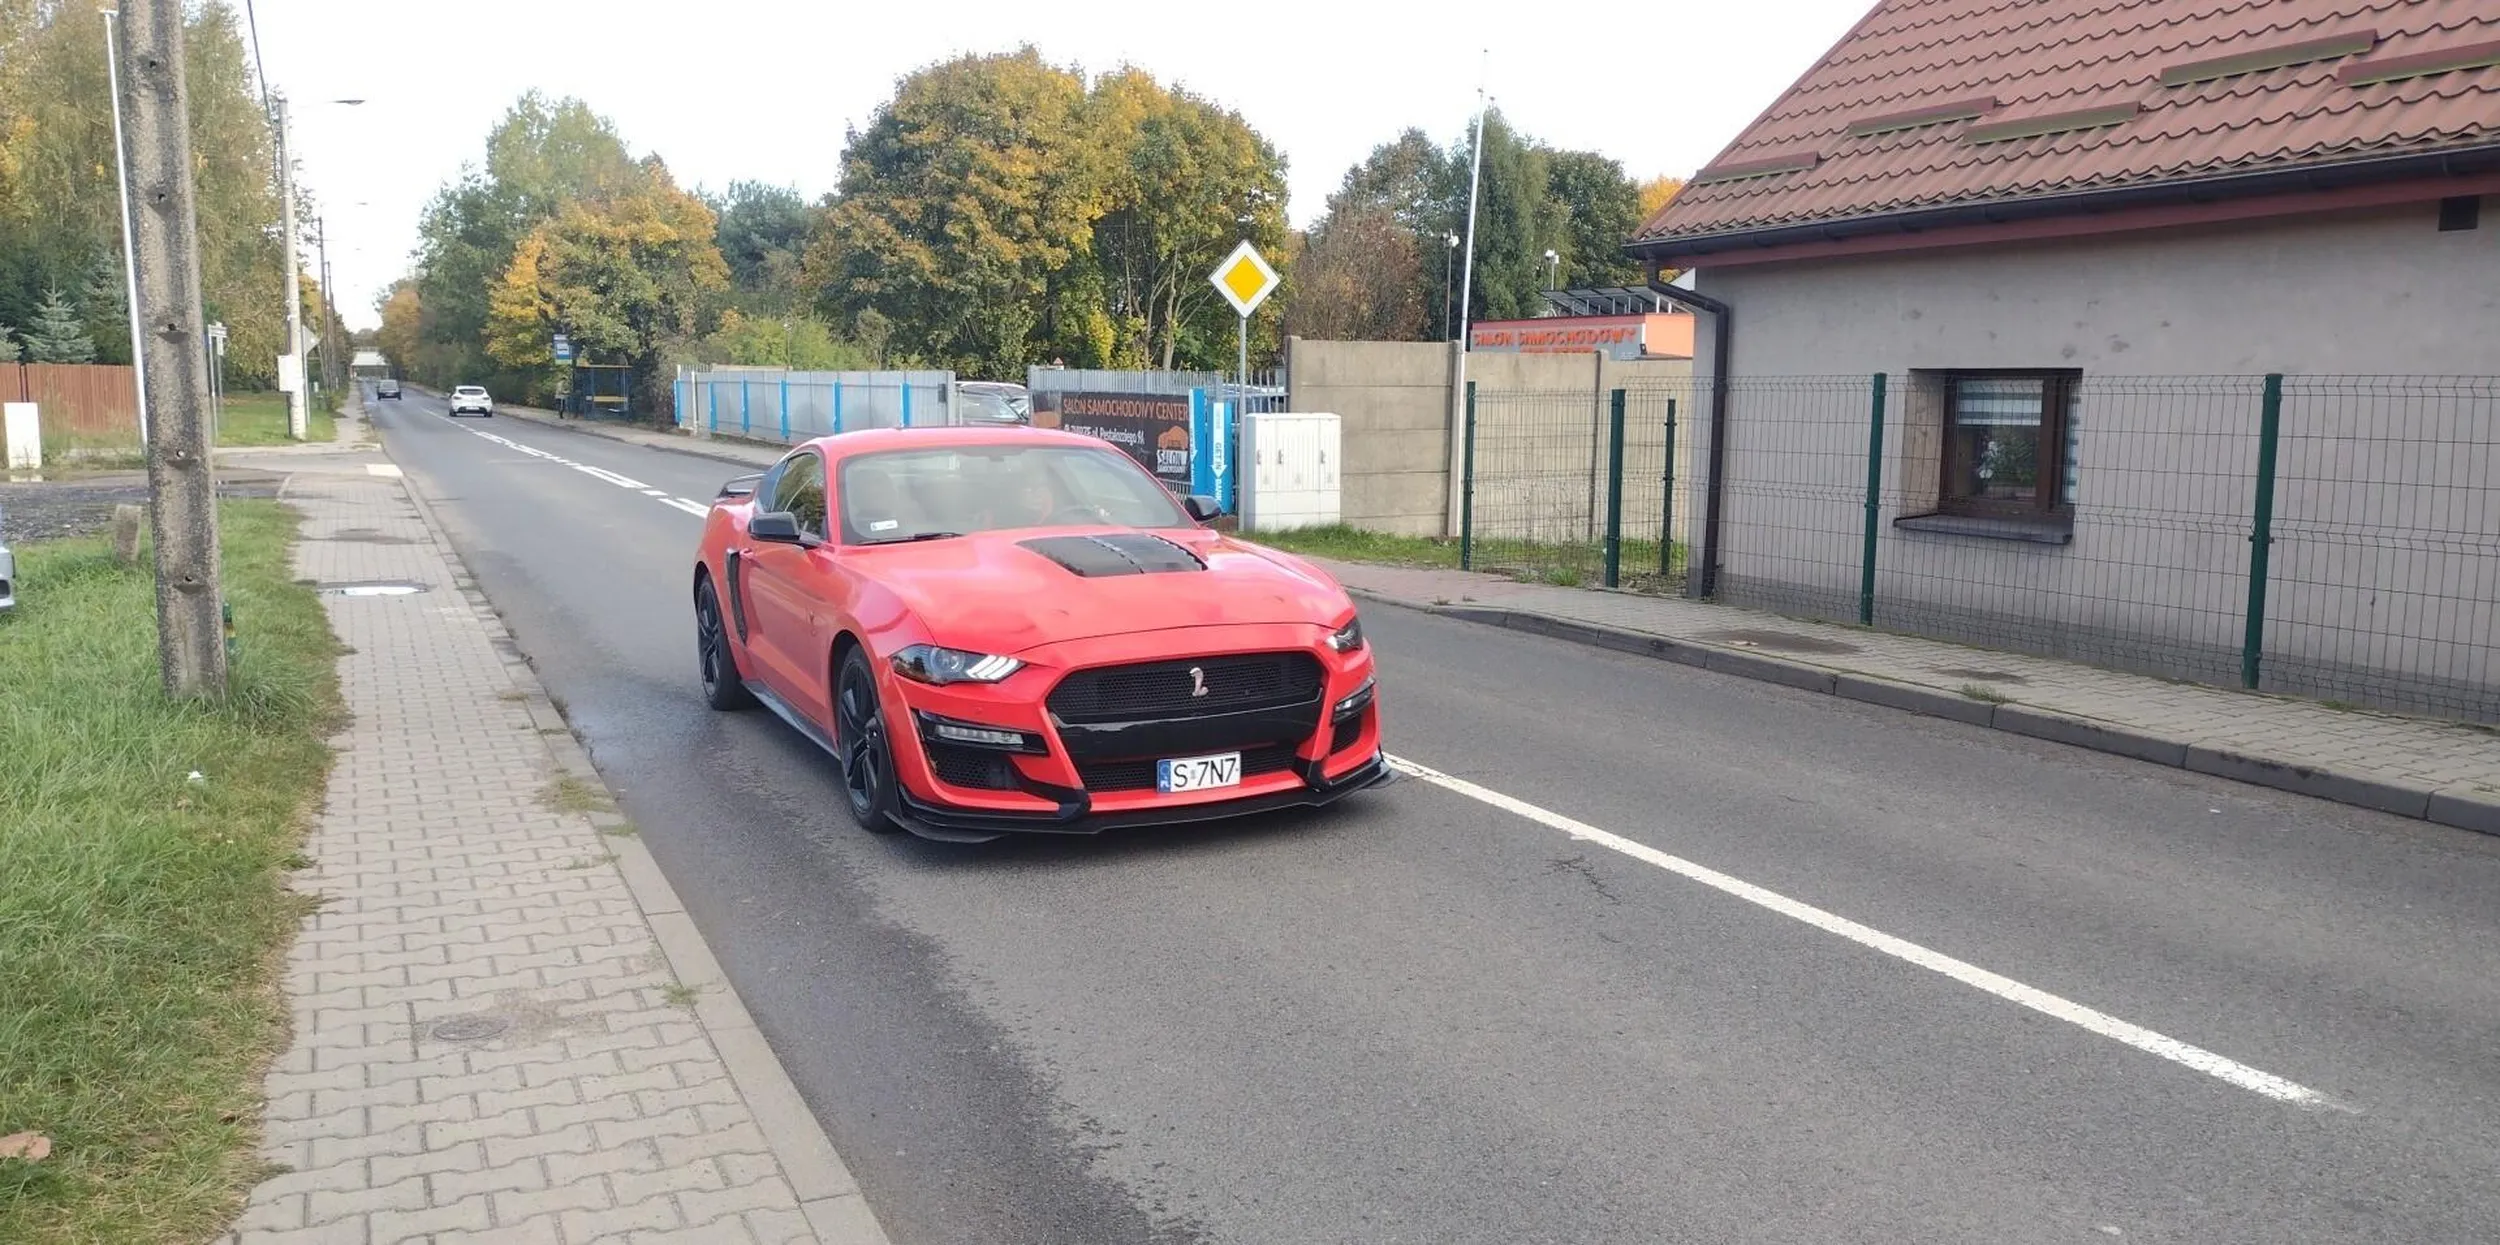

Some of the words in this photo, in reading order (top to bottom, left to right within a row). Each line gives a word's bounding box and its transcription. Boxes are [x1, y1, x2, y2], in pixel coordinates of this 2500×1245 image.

[1474, 331, 1513, 346] SALON
[1519, 327, 1637, 346] SAMOCHODOWY
[1064, 397, 1086, 414] SALON
[1086, 399, 1154, 418] SAMOCHODOWY
[1156, 402, 1188, 421] CENTER
